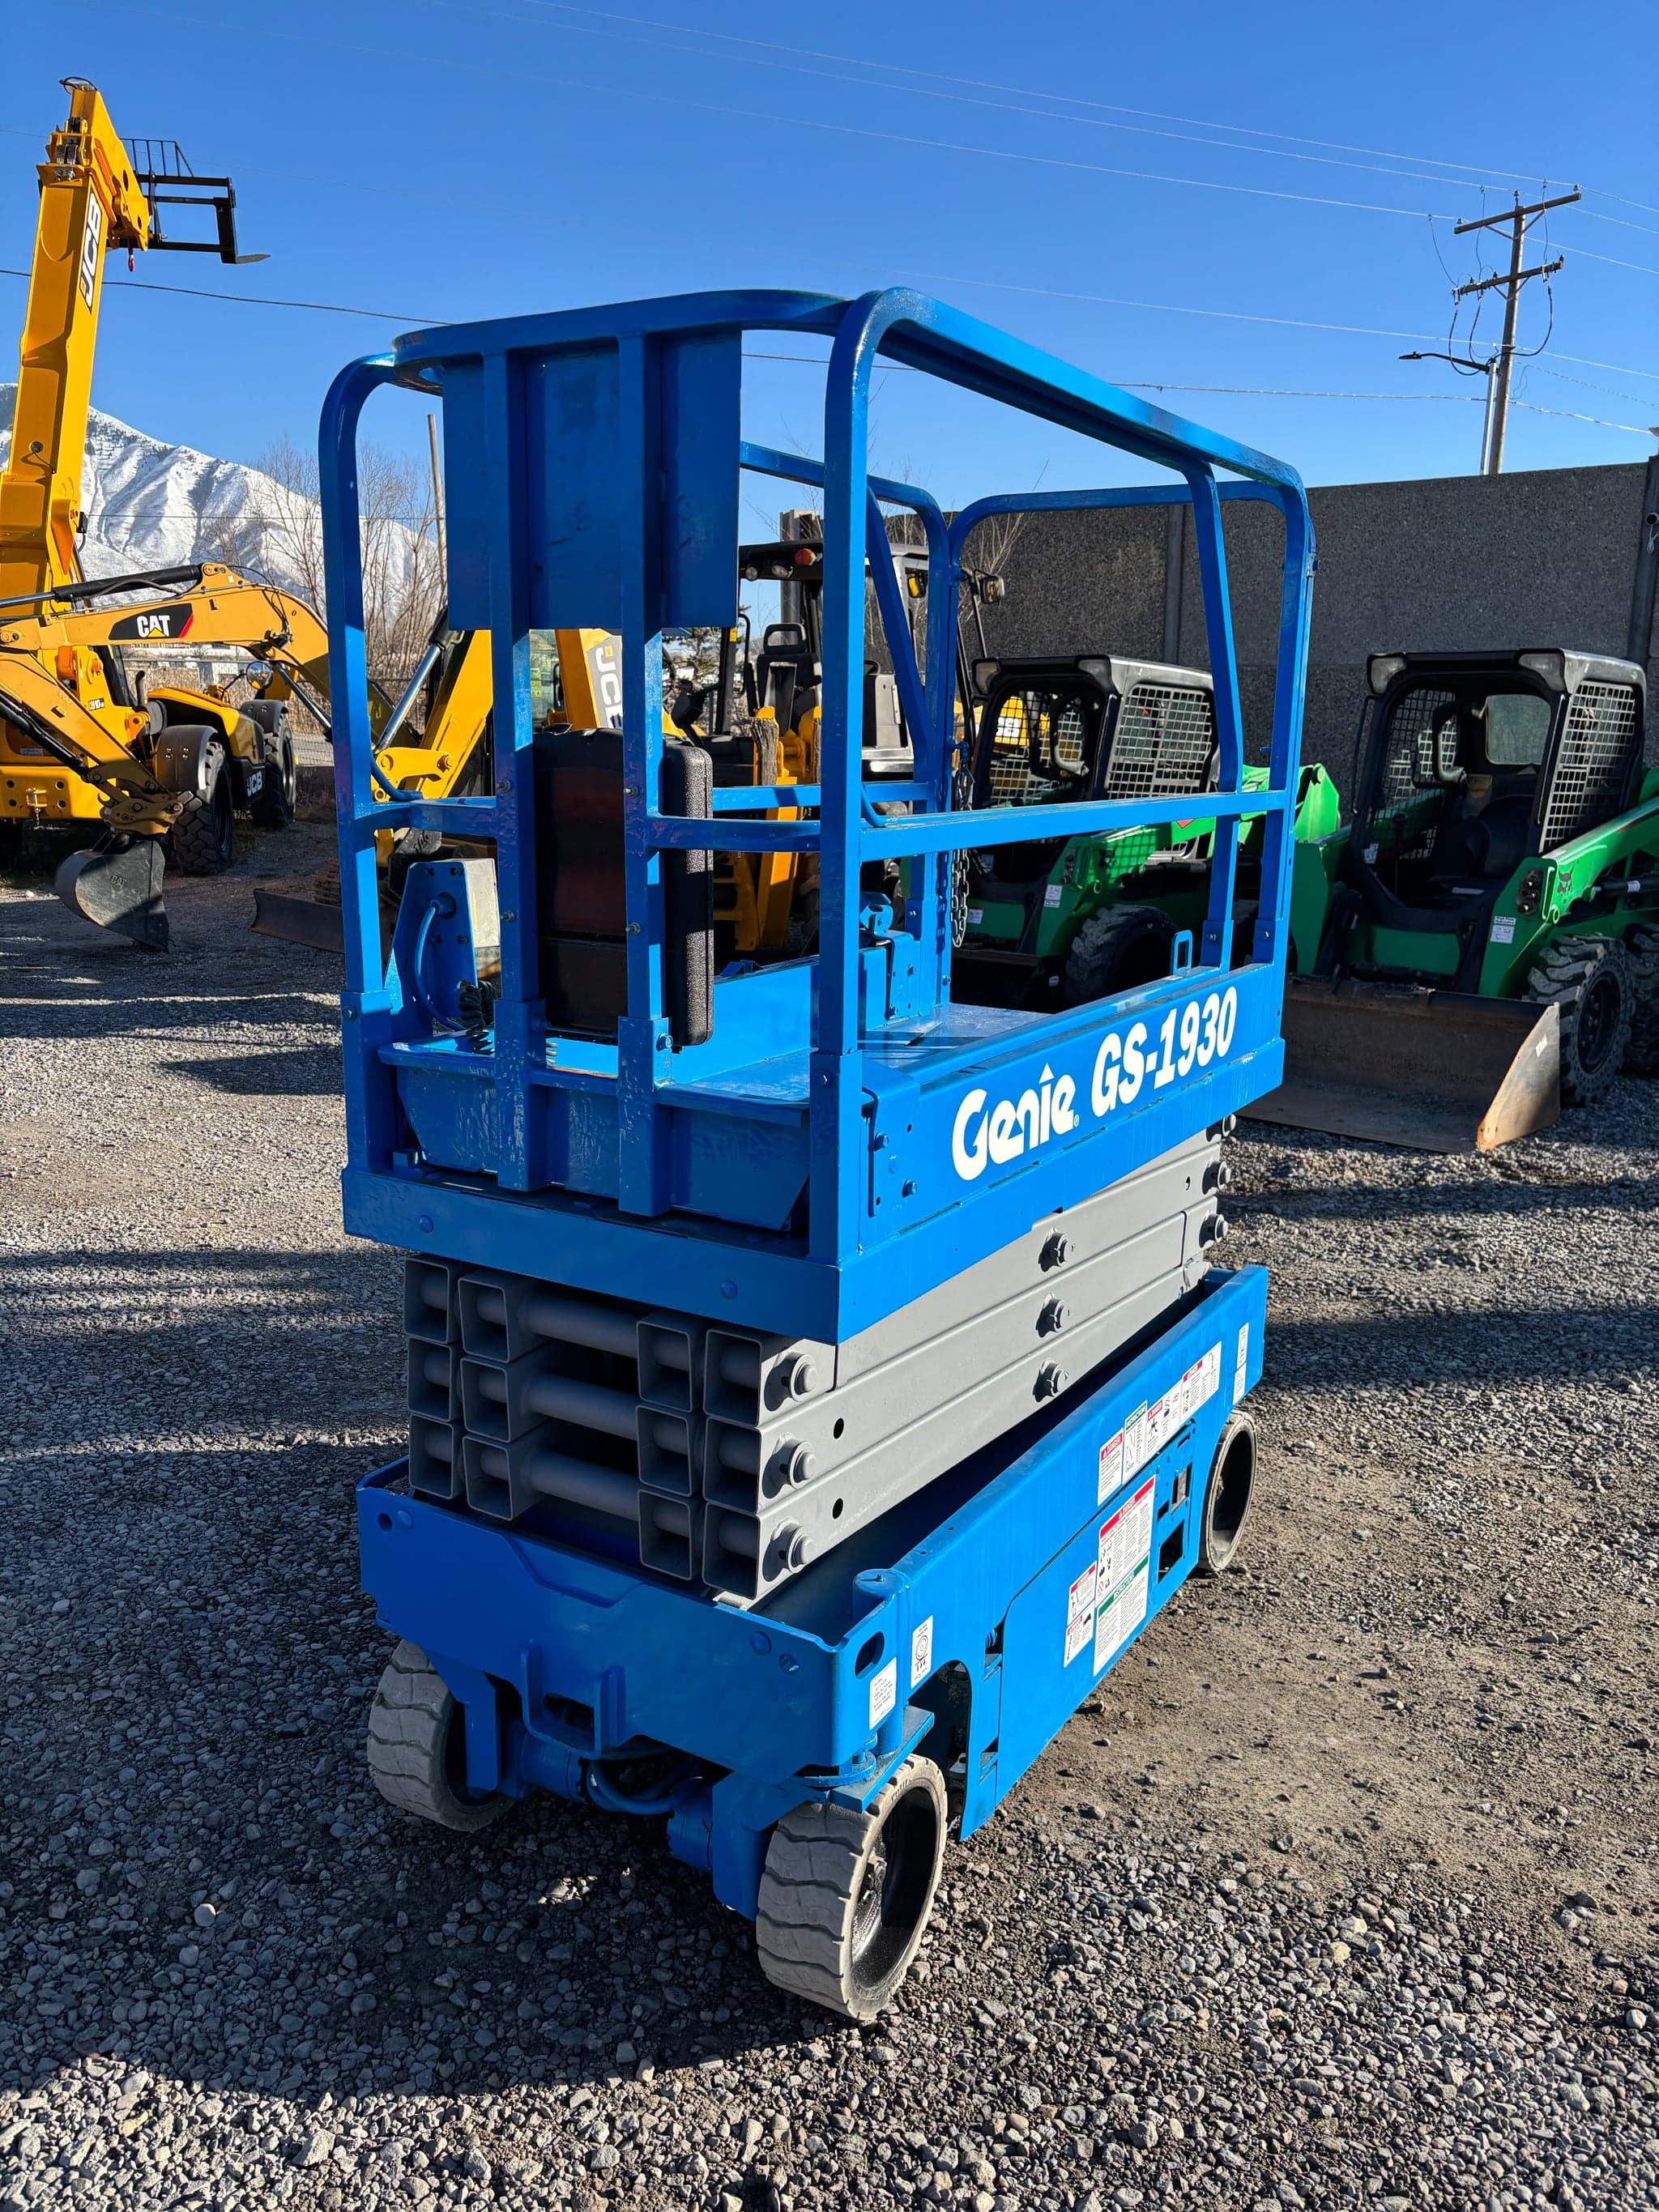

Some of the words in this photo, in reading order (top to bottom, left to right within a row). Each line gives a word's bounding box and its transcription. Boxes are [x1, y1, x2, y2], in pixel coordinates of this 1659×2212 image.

[81, 193, 102, 307] JCB
[136, 615, 170, 638] CAT
[246, 770, 263, 797] JCB
[952, 1063, 1076, 1180] Genie
[1091, 986, 1238, 1118] GS-1930
